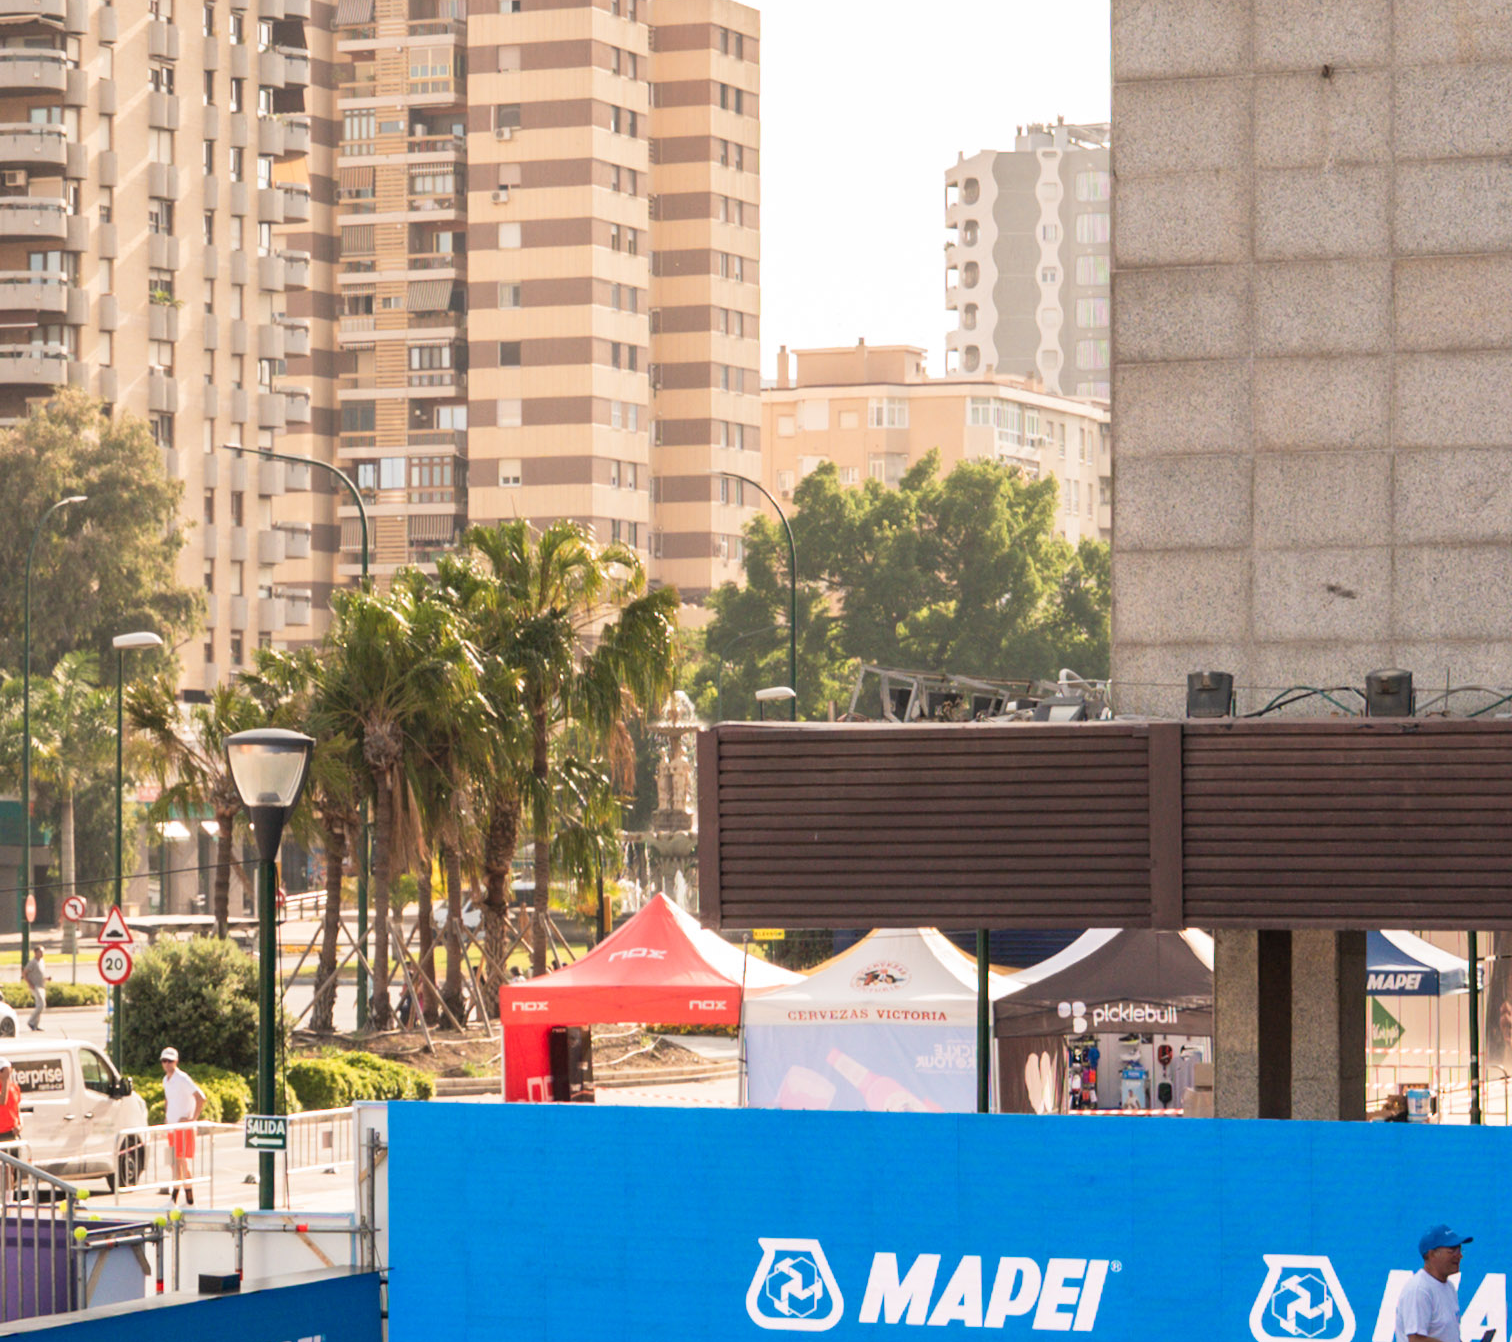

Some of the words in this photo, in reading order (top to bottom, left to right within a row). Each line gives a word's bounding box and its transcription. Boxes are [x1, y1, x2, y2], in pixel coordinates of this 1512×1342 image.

[105, 957, 123, 971] 20
[1367, 973, 1422, 990] MAPEI
[788, 1009, 869, 1021] CERVEZAS
[876, 1010, 947, 1022] VICTORIA
[1093, 1003, 1178, 1027] picklebull
[11, 1063, 63, 1089] terprise
[247, 1120, 286, 1135] SALIDA
